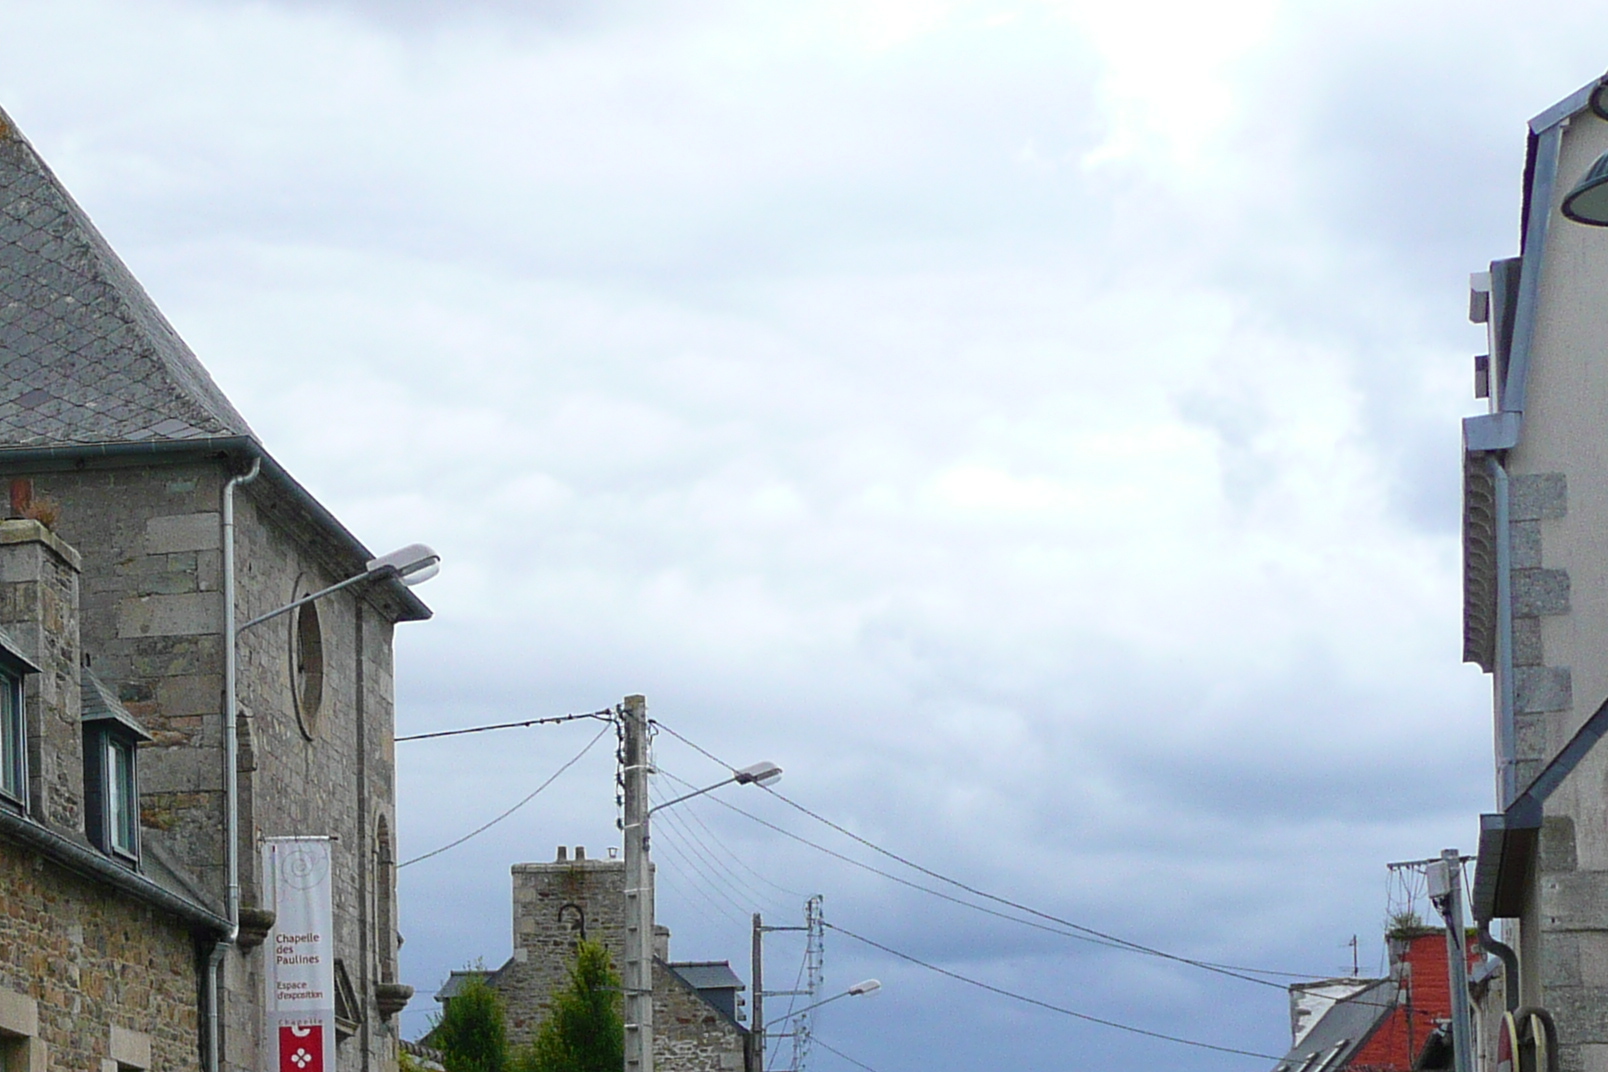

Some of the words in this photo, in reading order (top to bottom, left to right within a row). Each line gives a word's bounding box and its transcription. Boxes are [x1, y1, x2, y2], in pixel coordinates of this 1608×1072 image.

[276, 933, 320, 945] Chapelle
[276, 945, 294, 954] des
[276, 955, 320, 965] Paulines
[277, 981, 307, 991] Espace
[277, 990, 324, 1000] d'exposition
